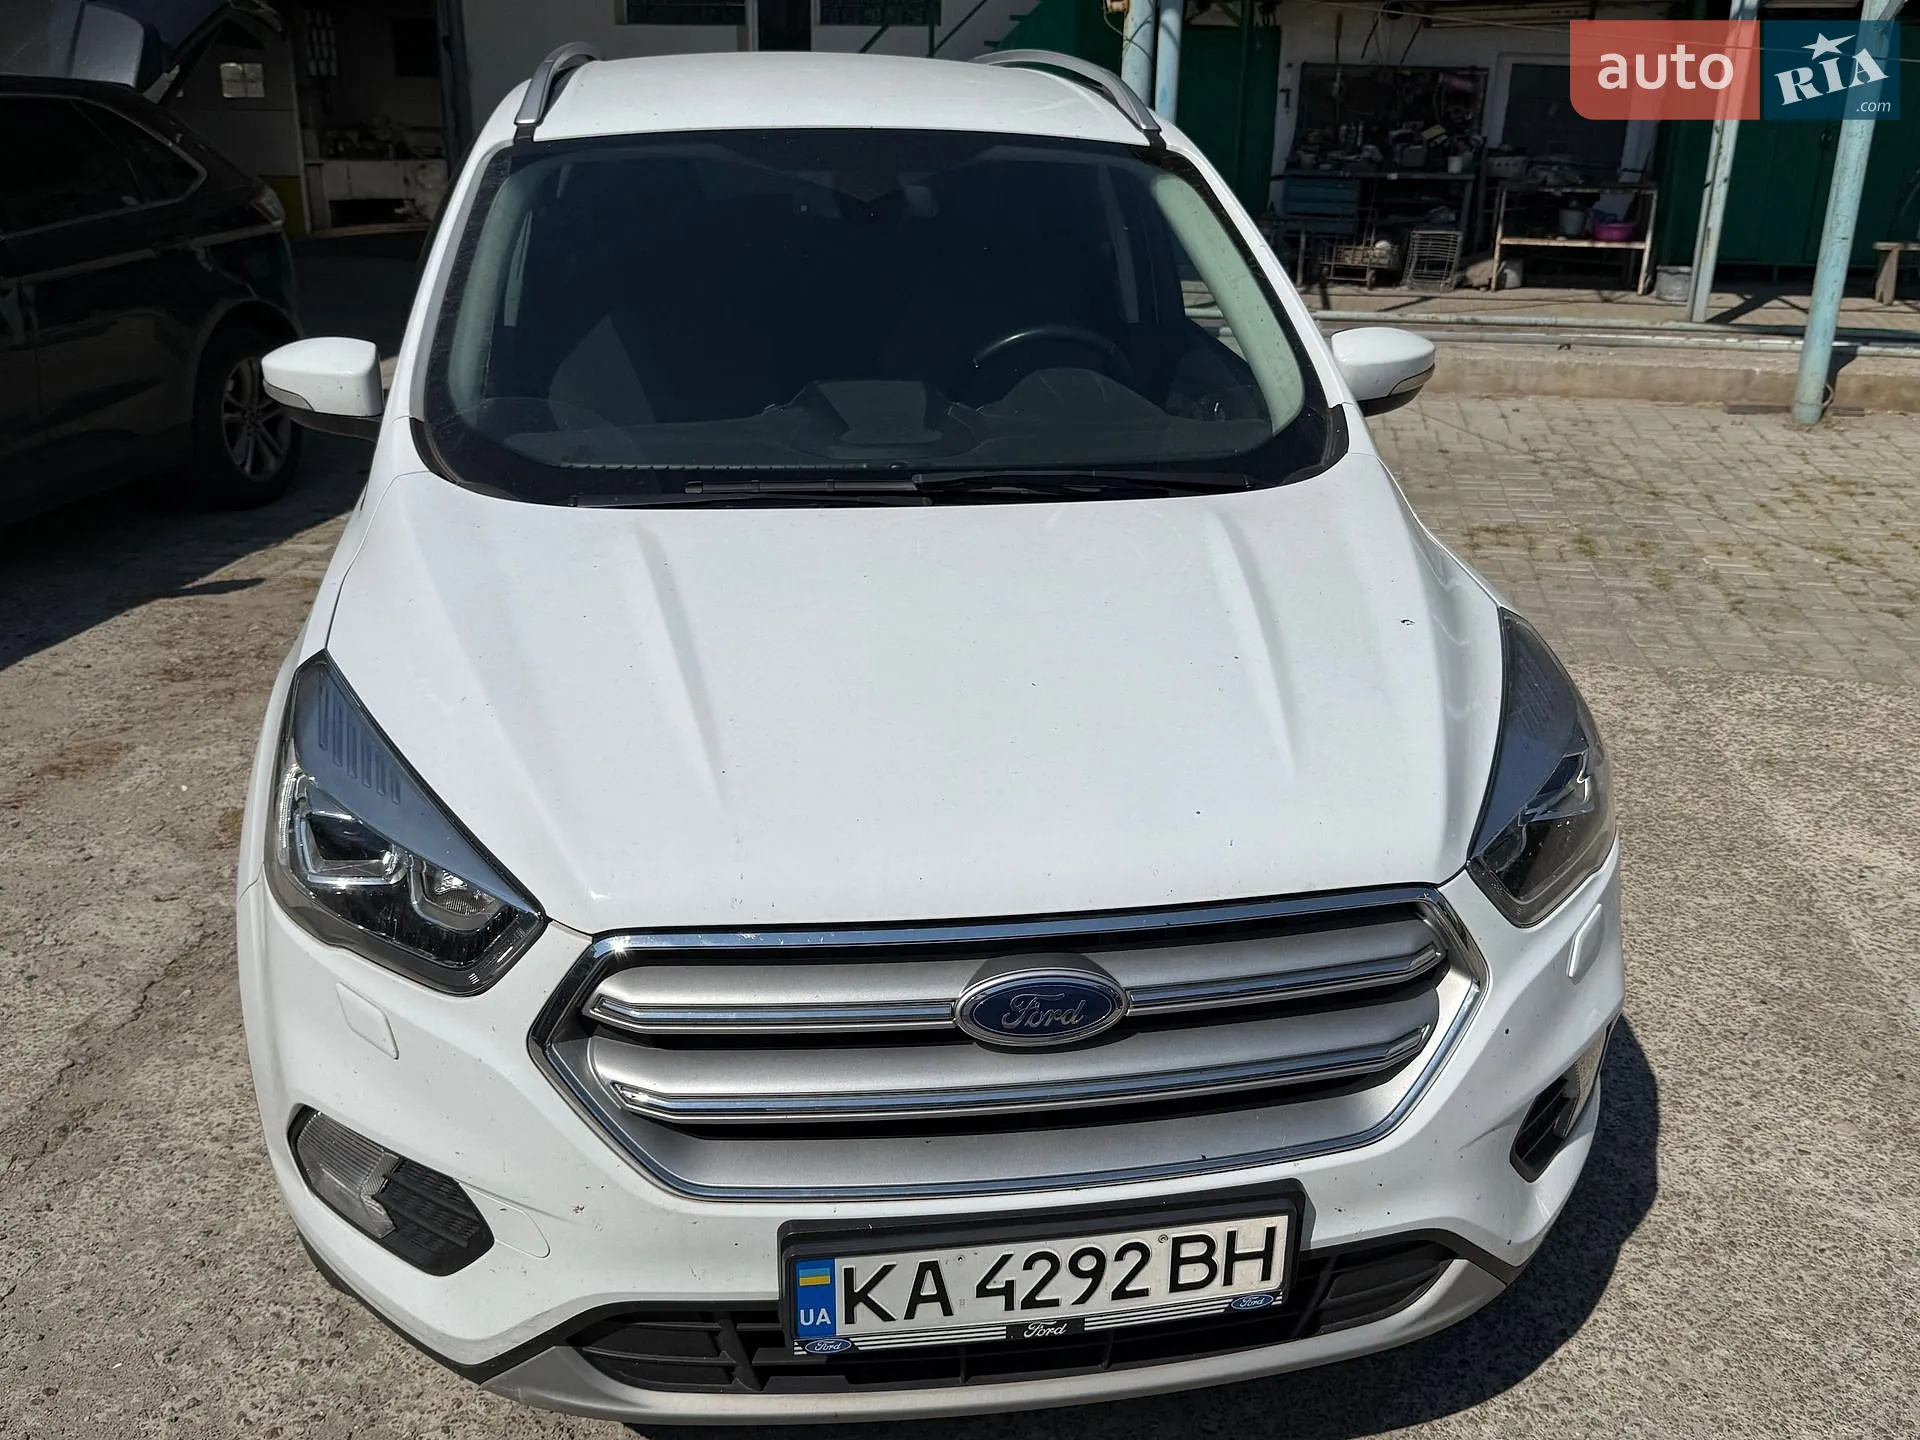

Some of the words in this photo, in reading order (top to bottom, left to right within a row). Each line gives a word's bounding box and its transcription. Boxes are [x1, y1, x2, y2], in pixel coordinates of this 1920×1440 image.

[1002, 993, 1086, 1028] Ford
[843, 1260, 954, 1325] KA
[975, 1242, 1151, 1312] 4292
[1169, 1226, 1277, 1292] BH
[1239, 1296, 1265, 1308] Ford
[800, 1308, 832, 1327] UA
[1023, 1321, 1067, 1337] Ford
[814, 1340, 842, 1351] Ford
